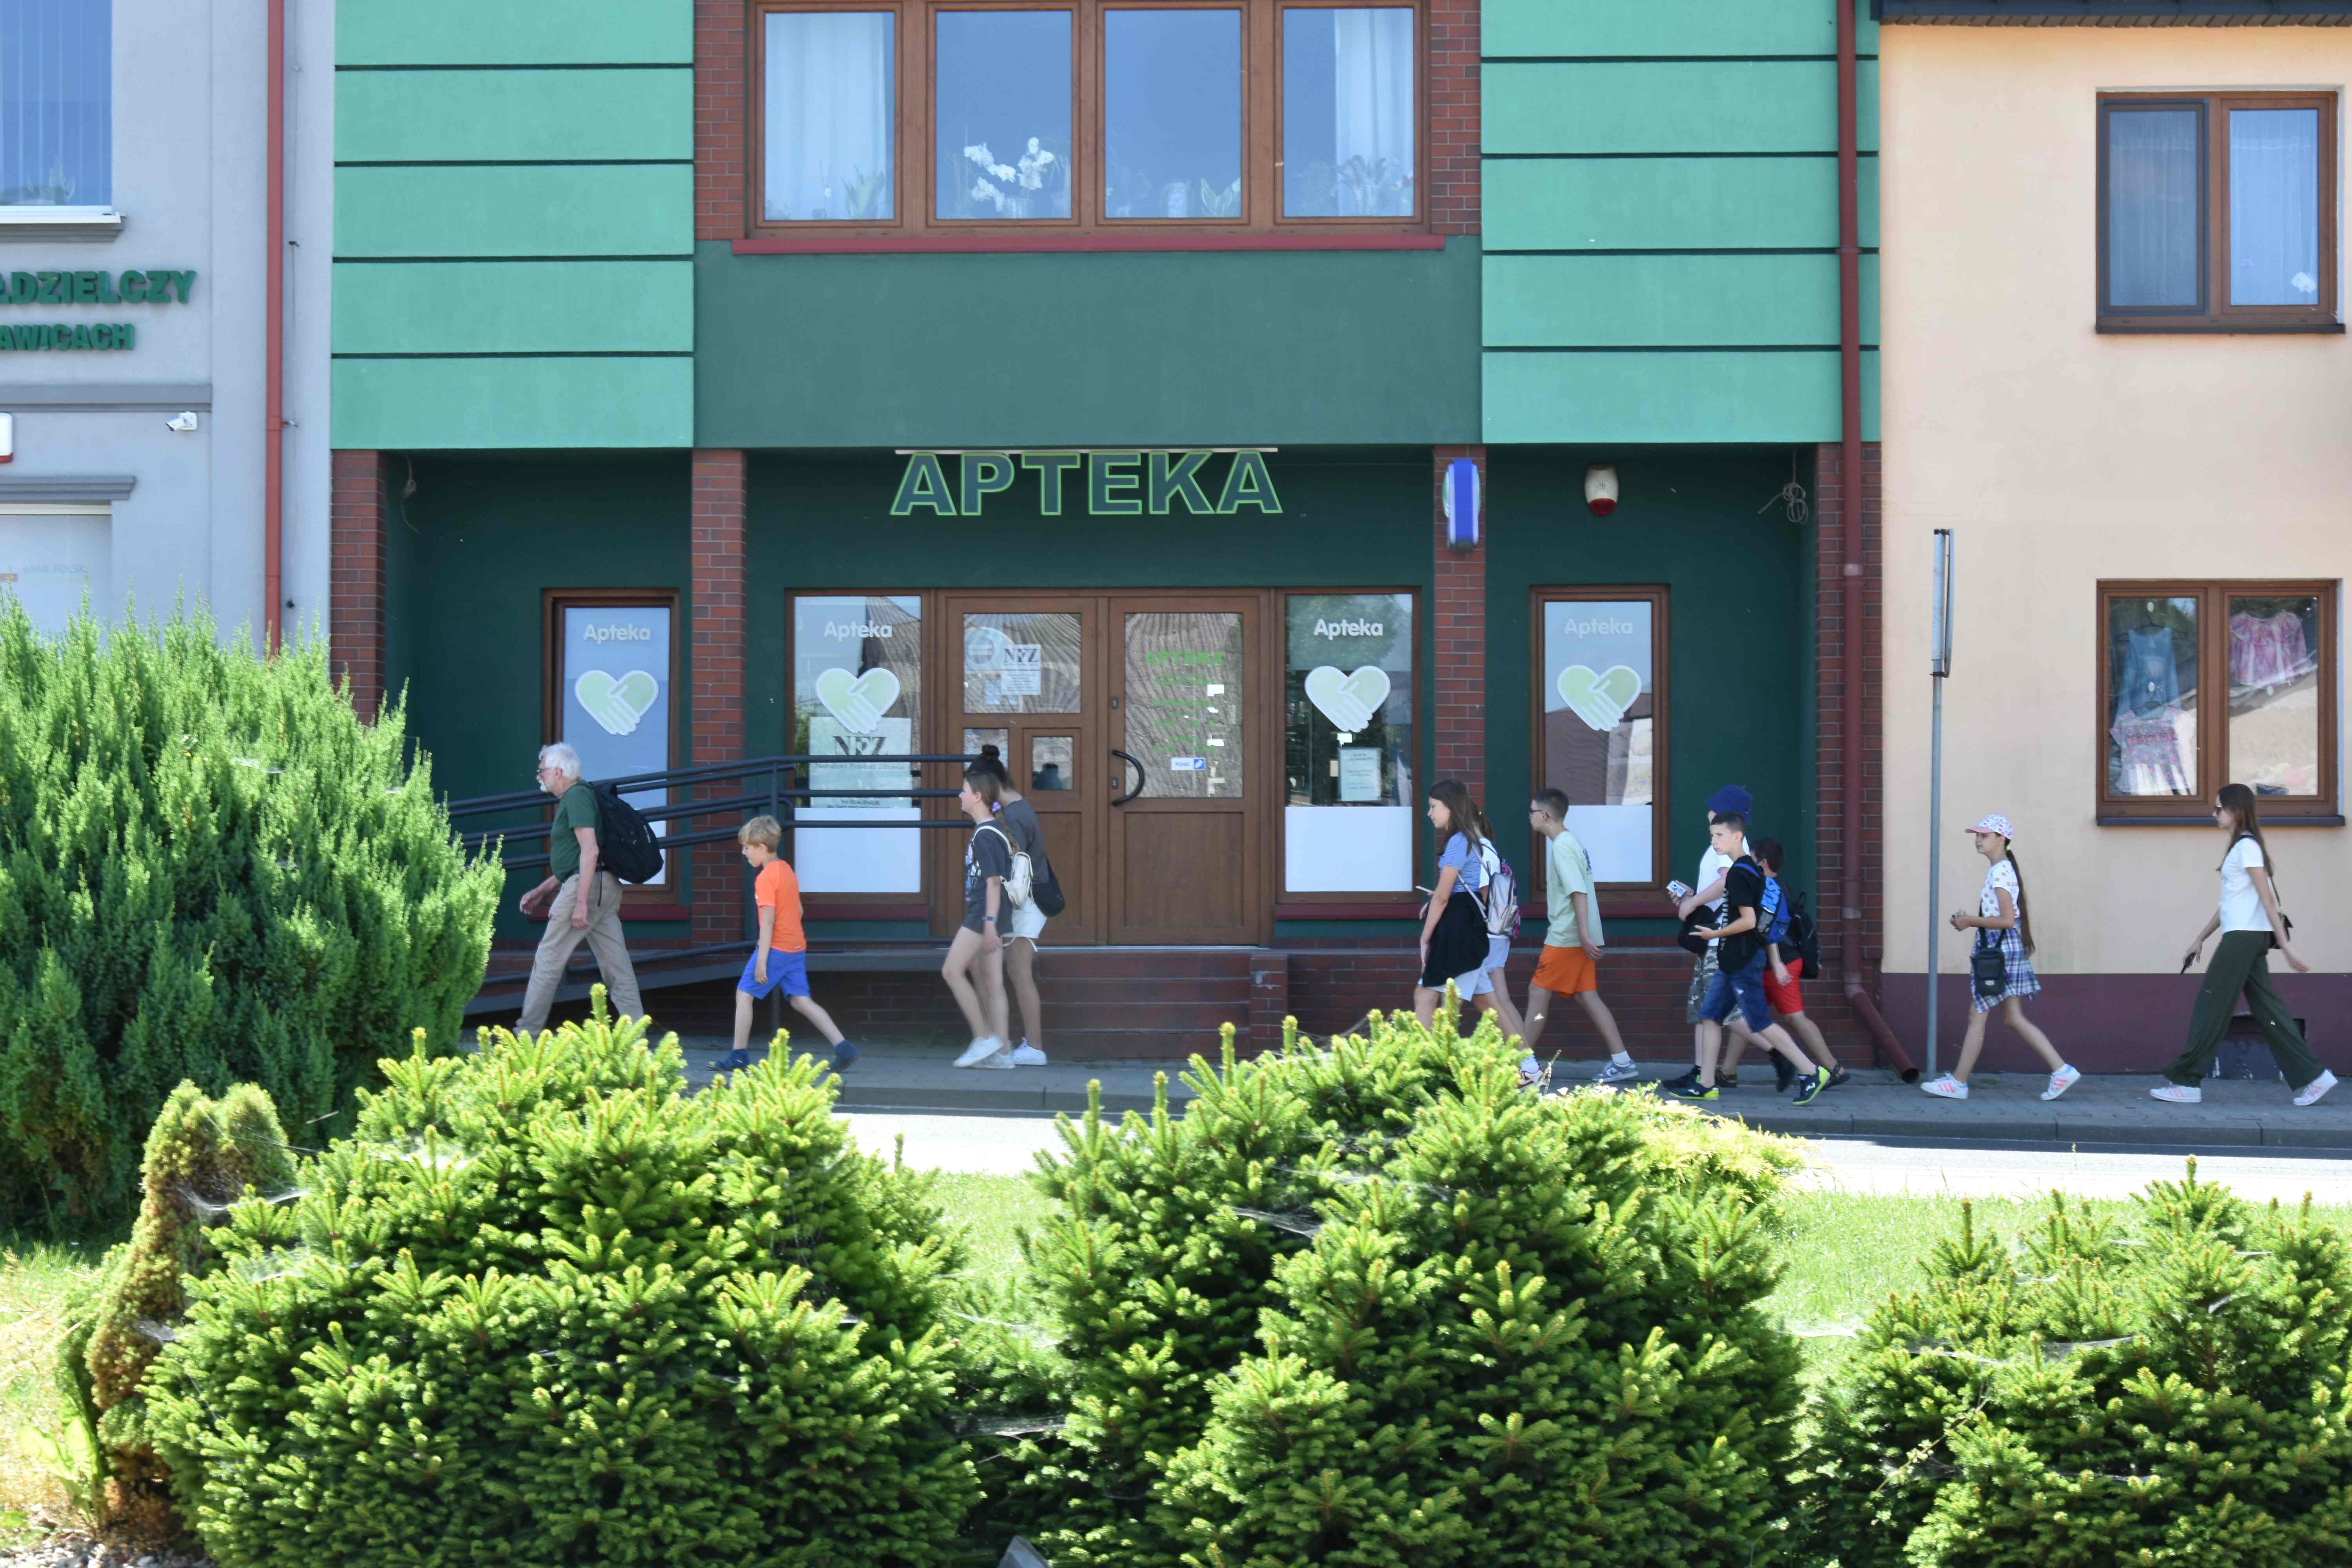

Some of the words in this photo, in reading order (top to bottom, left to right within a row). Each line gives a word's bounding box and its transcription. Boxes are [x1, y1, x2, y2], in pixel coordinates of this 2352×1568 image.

[890, 451, 1283, 516] APTEKA
[583, 623, 652, 645] Apteka
[823, 620, 893, 642] Apteka
[1314, 618, 1384, 641] Apteka
[1564, 617, 1633, 639] Apteka
[1003, 648, 1039, 662] NFZ
[1145, 652, 1225, 665] APTEKA
